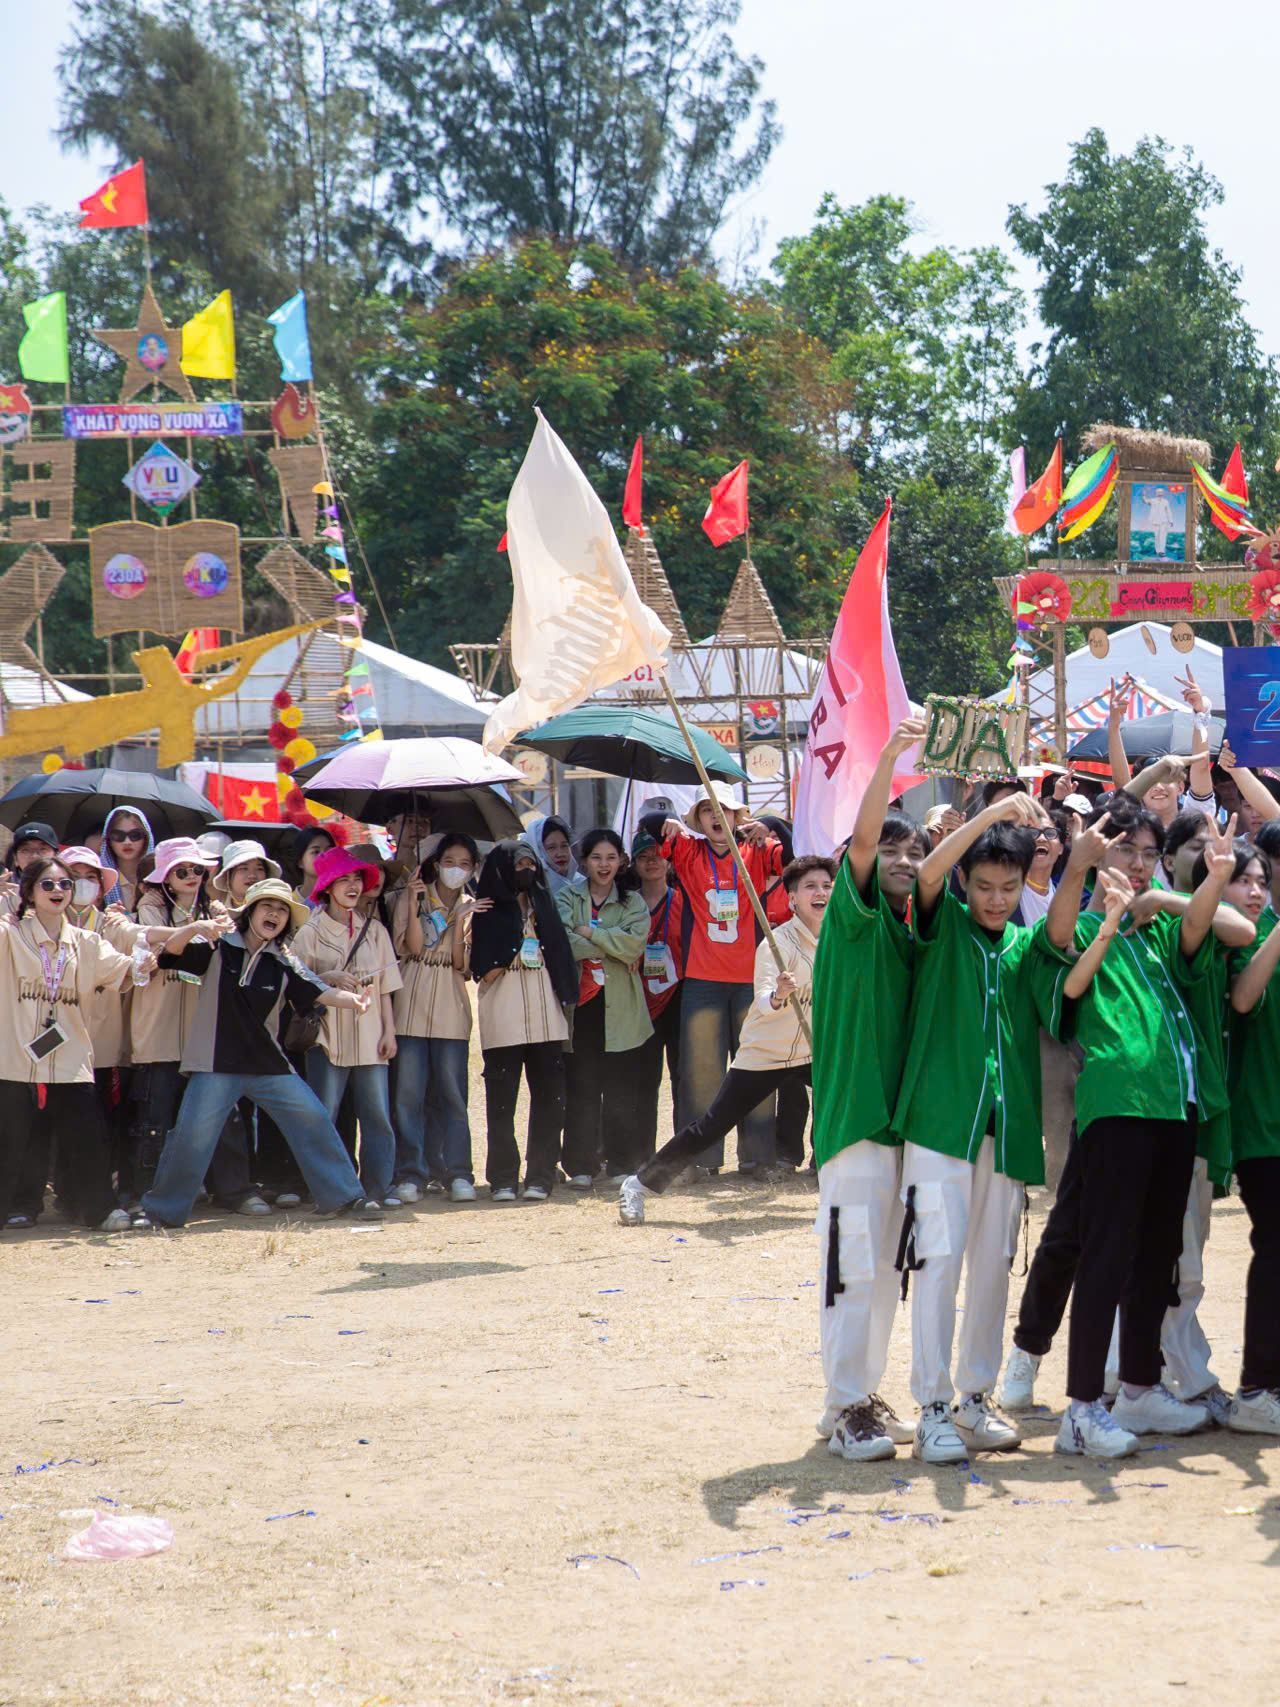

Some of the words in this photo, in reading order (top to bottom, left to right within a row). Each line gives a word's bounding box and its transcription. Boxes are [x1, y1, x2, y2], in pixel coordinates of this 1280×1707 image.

[76, 411, 115, 431] KHÁT
[207, 411, 229, 429] XA
[142, 466, 178, 487] VKU
[1070, 578, 1111, 617] 23
[926, 700, 1018, 777] DA
